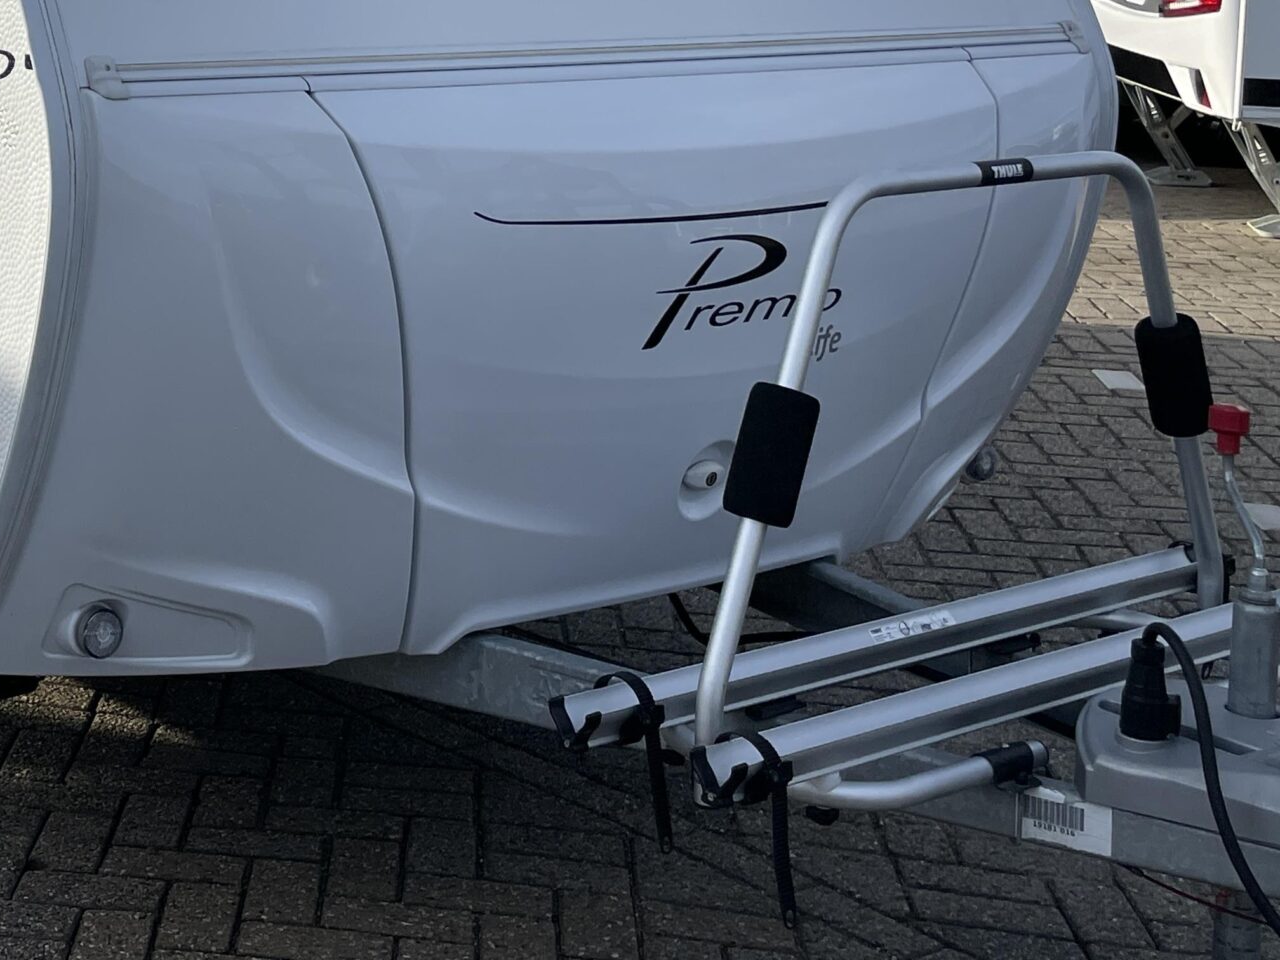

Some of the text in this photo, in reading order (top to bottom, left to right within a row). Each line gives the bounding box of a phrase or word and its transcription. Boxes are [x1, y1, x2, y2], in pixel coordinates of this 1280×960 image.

[991, 163, 1024, 179] THULE
[641, 234, 842, 350] Premo
[809, 324, 842, 362] ife
